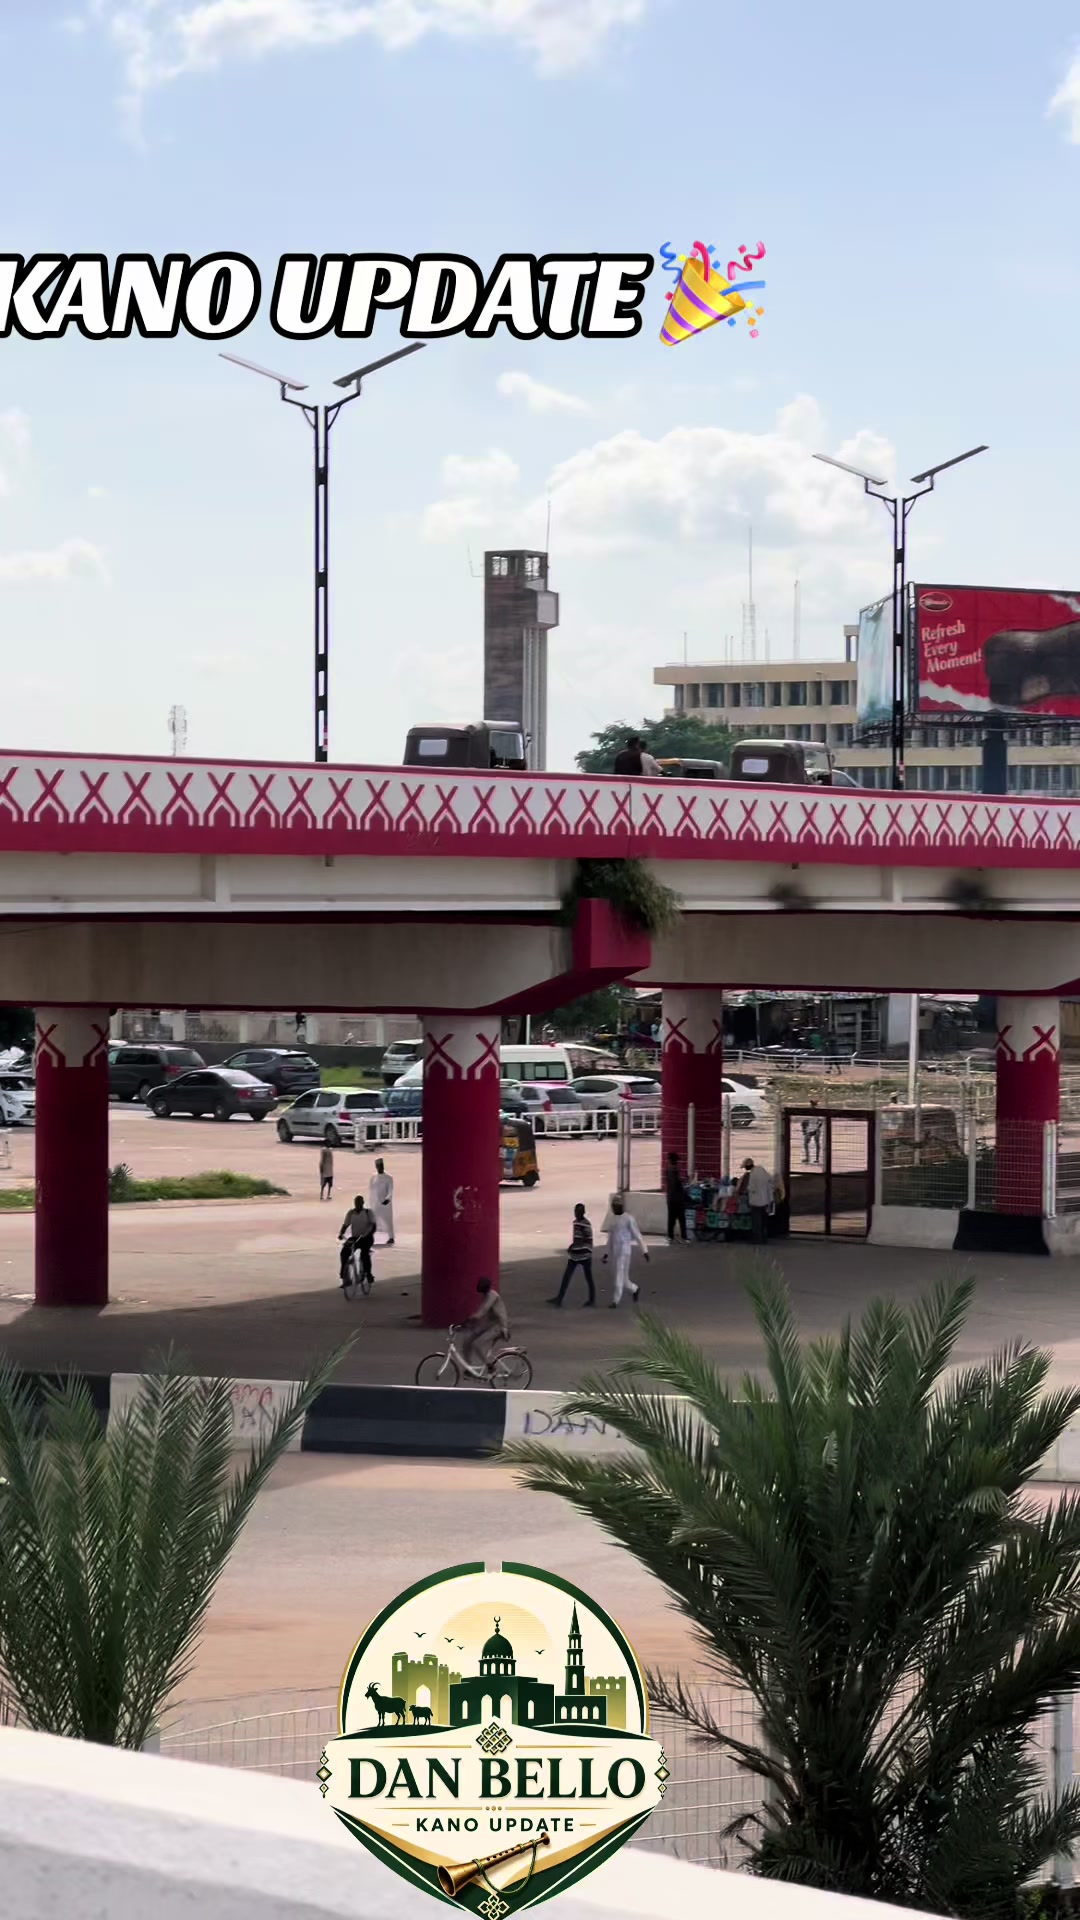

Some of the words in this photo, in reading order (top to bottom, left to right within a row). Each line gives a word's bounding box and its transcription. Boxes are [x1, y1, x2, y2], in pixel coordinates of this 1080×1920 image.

[922, 619, 965, 642] Refresh
[923, 641, 958, 658] Every
[926, 648, 982, 673] Moment!
